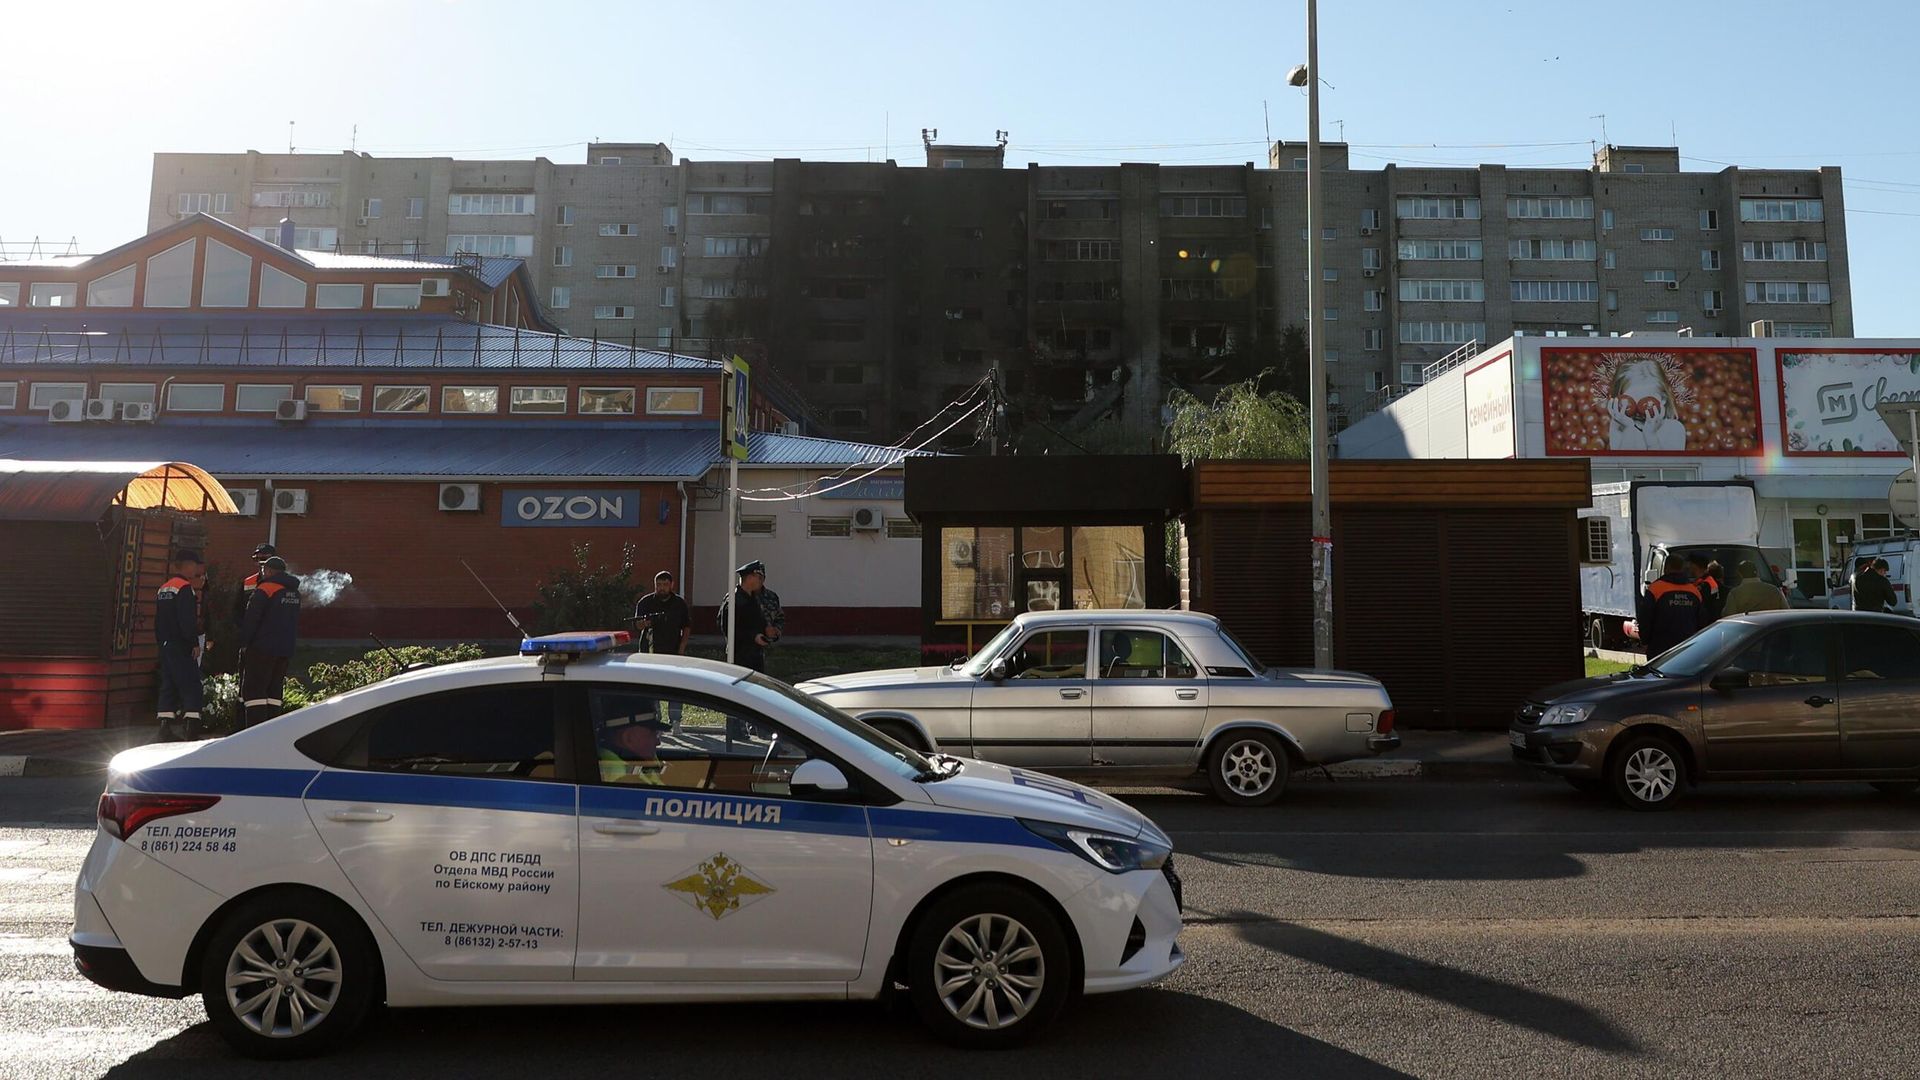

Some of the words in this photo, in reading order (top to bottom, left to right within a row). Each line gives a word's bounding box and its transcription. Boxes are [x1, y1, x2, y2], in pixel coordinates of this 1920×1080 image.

[517, 496, 623, 520] OZON
[117, 525, 137, 650] ЦВЕТЫ
[645, 797, 781, 824] ПОЛИЦИЯ
[146, 826, 171, 837] ТЕЛ.
[174, 826, 236, 838] ДОВЕРИЯ
[141, 841, 147, 851] 8
[151, 841, 178, 853] (861)
[182, 841, 201, 852] 224
[205, 842, 219, 852] 58
[222, 842, 236, 852] 48
[449, 851, 467, 861] ОВ
[470, 852, 496, 863] ДПС
[500, 853, 541, 866] ГИБДД
[433, 864, 477, 876] Отдела
[481, 866, 508, 878] МВД
[512, 868, 555, 879] России
[435, 880, 450, 888] по
[453, 879, 505, 892] Ейскому
[508, 880, 551, 894] району
[420, 922, 446, 933] ТЕЛ.
[449, 923, 517, 935] ДЕЖУРНОЙ
[521, 927, 564, 938] ЧАСТИ:
[444, 936, 451, 945] 8
[454, 936, 495, 948] (86132)
[498, 939, 538, 949] 2-57-13
